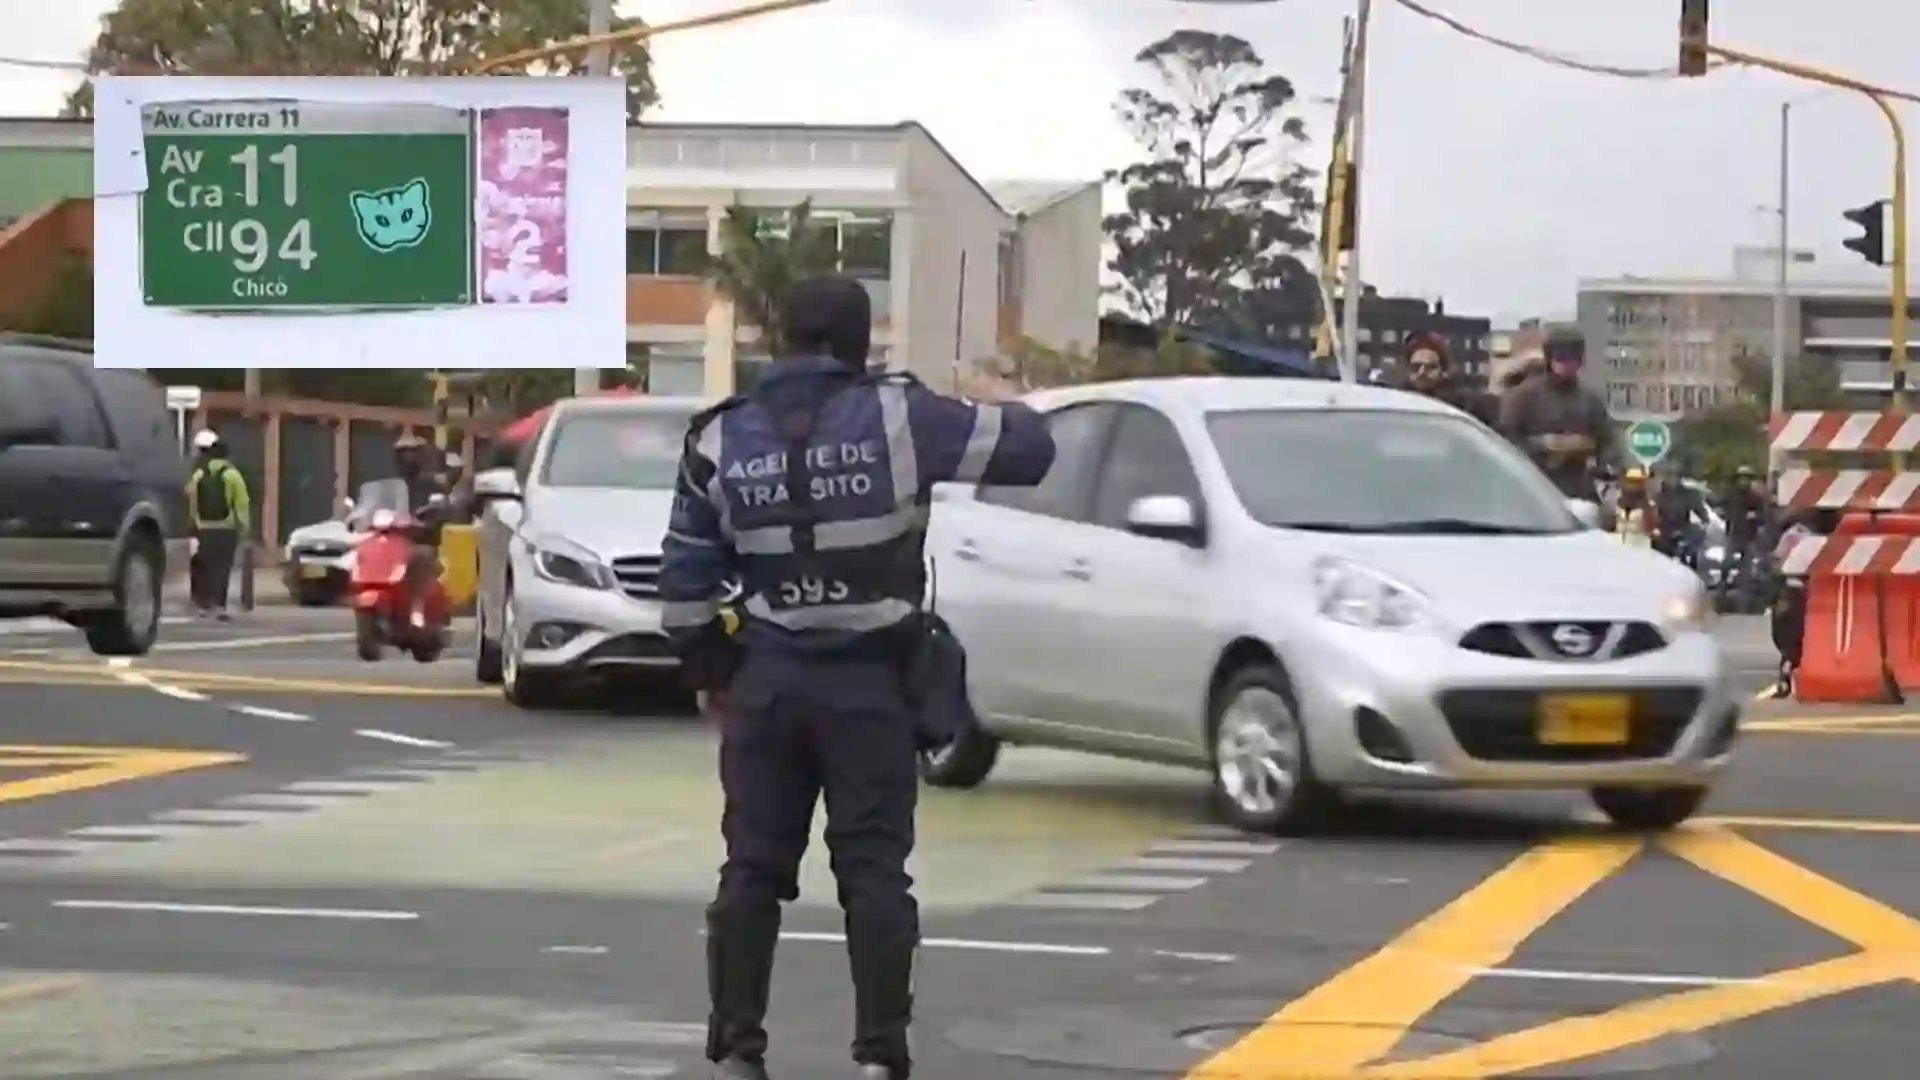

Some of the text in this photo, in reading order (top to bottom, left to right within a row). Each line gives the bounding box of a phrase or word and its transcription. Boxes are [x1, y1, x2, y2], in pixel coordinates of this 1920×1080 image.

[188, 108, 270, 128] Carrera
[280, 107, 299, 128] 11
[160, 144, 205, 175] Av
[167, 144, 298, 208] Cra 11
[183, 218, 318, 273] Cll 94
[841, 440, 877, 465] DE
[738, 473, 872, 507] TRASITO
